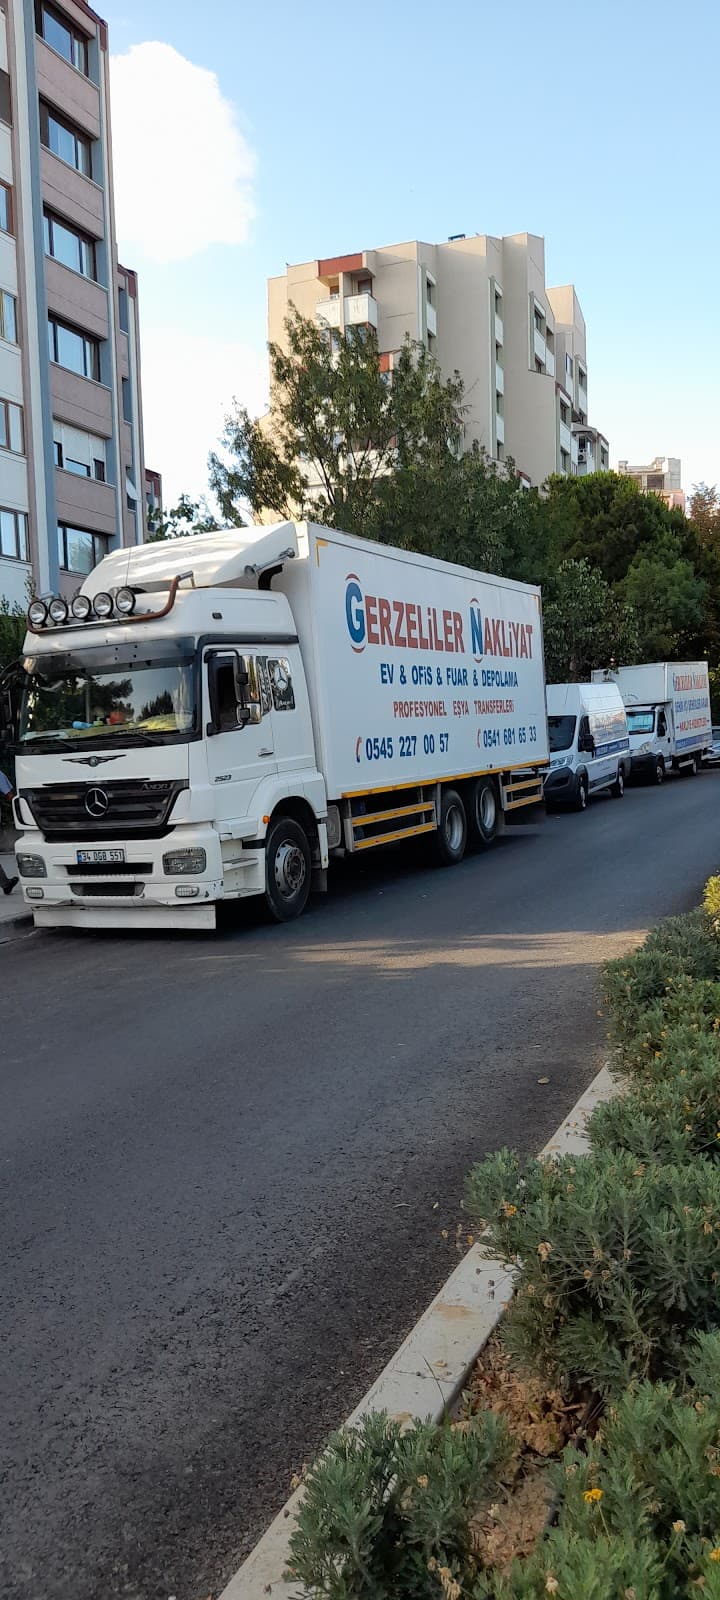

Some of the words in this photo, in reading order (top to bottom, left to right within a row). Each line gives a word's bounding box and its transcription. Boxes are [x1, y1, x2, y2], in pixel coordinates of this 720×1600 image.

[380, 663, 394, 685] EV
[399, 666, 407, 685] &
[436, 667, 443, 686] &
[446, 667, 469, 687] FUAR
[473, 669, 479, 687] &
[481, 669, 519, 688] DEPOLAMA
[393, 701, 447, 718] PROFESYONEL
[365, 736, 394, 761] 0545
[399, 735, 417, 757] 227
[423, 734, 435, 755] 00
[439, 732, 449, 753] 57
[483, 729, 500, 748] 0541
[503, 728, 516, 746] 681
[518, 727, 527, 744] 65
[529, 726, 537, 742] 33
[81, 852, 91, 861] 34
[109, 851, 122, 861] 551
